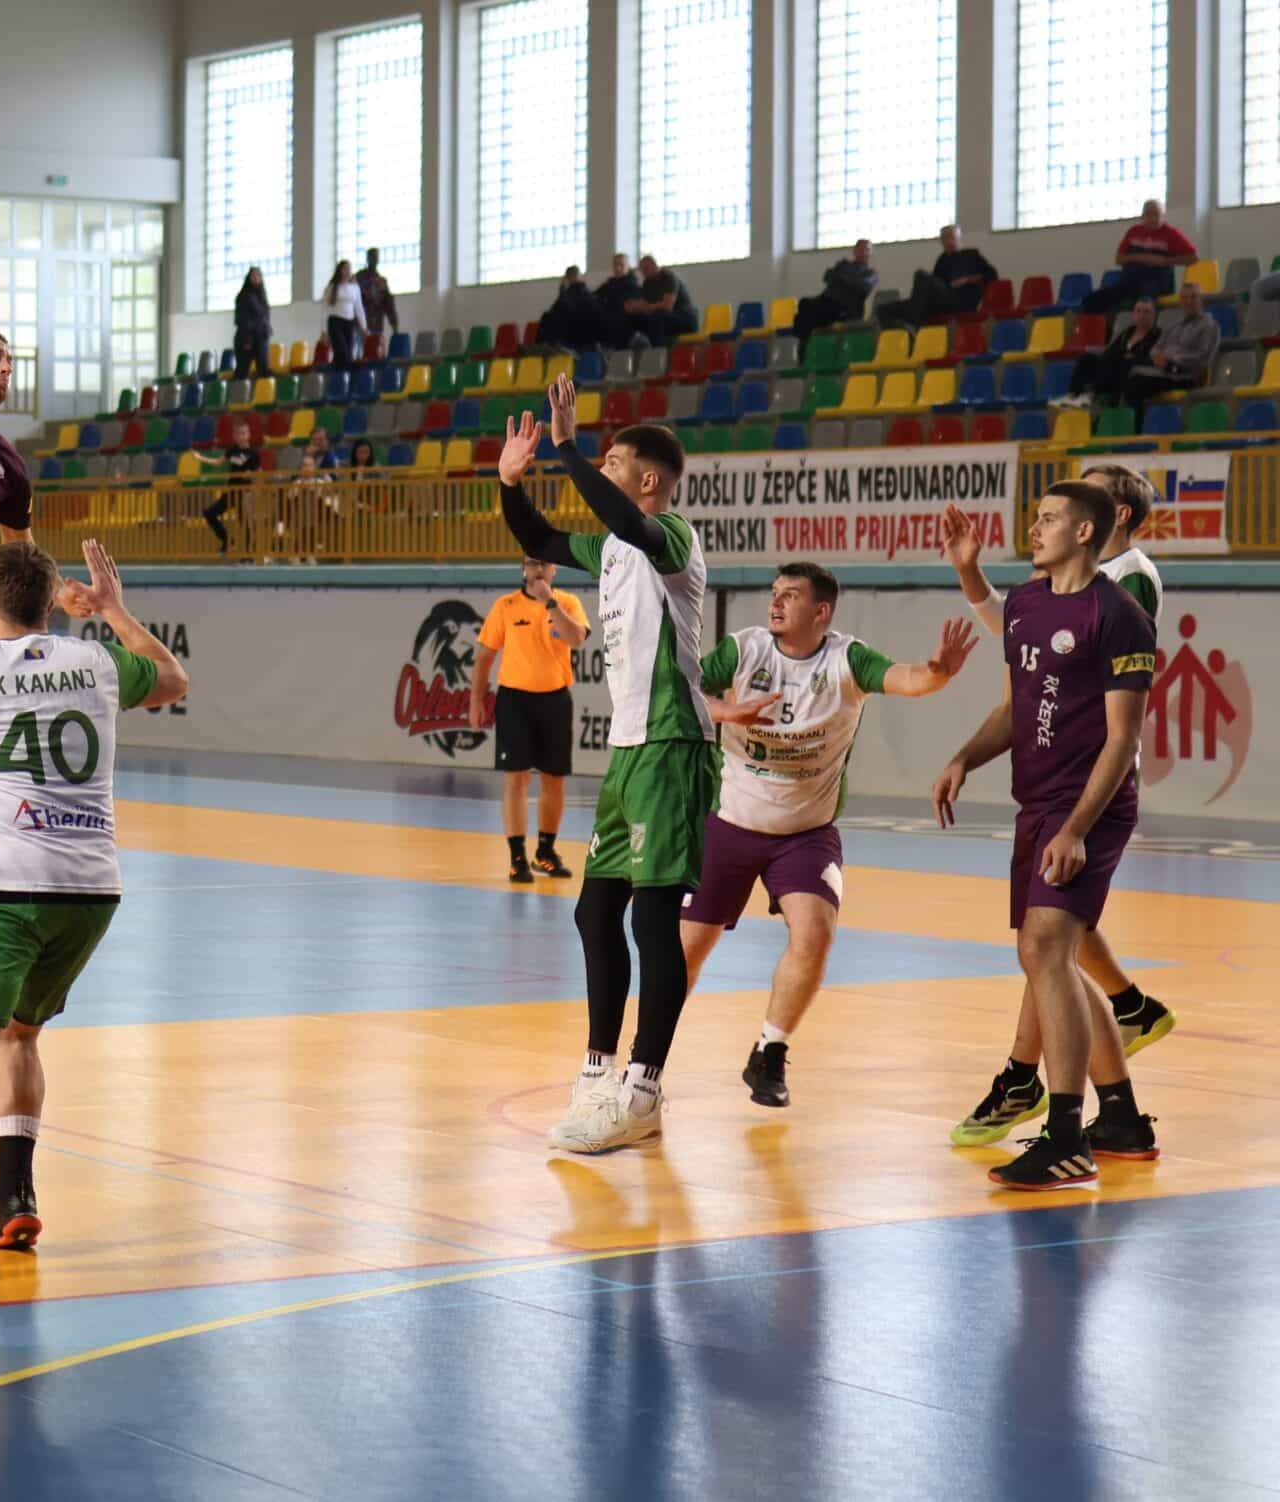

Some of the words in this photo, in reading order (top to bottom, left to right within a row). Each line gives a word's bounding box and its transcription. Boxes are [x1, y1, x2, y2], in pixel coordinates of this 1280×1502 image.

[687, 462, 737, 507] DOŠLI
[744, 472, 756, 505] U
[762, 456, 817, 504] ŽEPČE
[825, 469, 850, 504] NA
[857, 461, 1007, 503] MEĐUNARODNI
[693, 517, 767, 551] TENISKI
[773, 515, 848, 551] TURNIR
[1020, 644, 1040, 672] 15
[15, 668, 97, 694] KAKANJ
[1042, 674, 1059, 697] RK
[780, 702, 795, 725] 5
